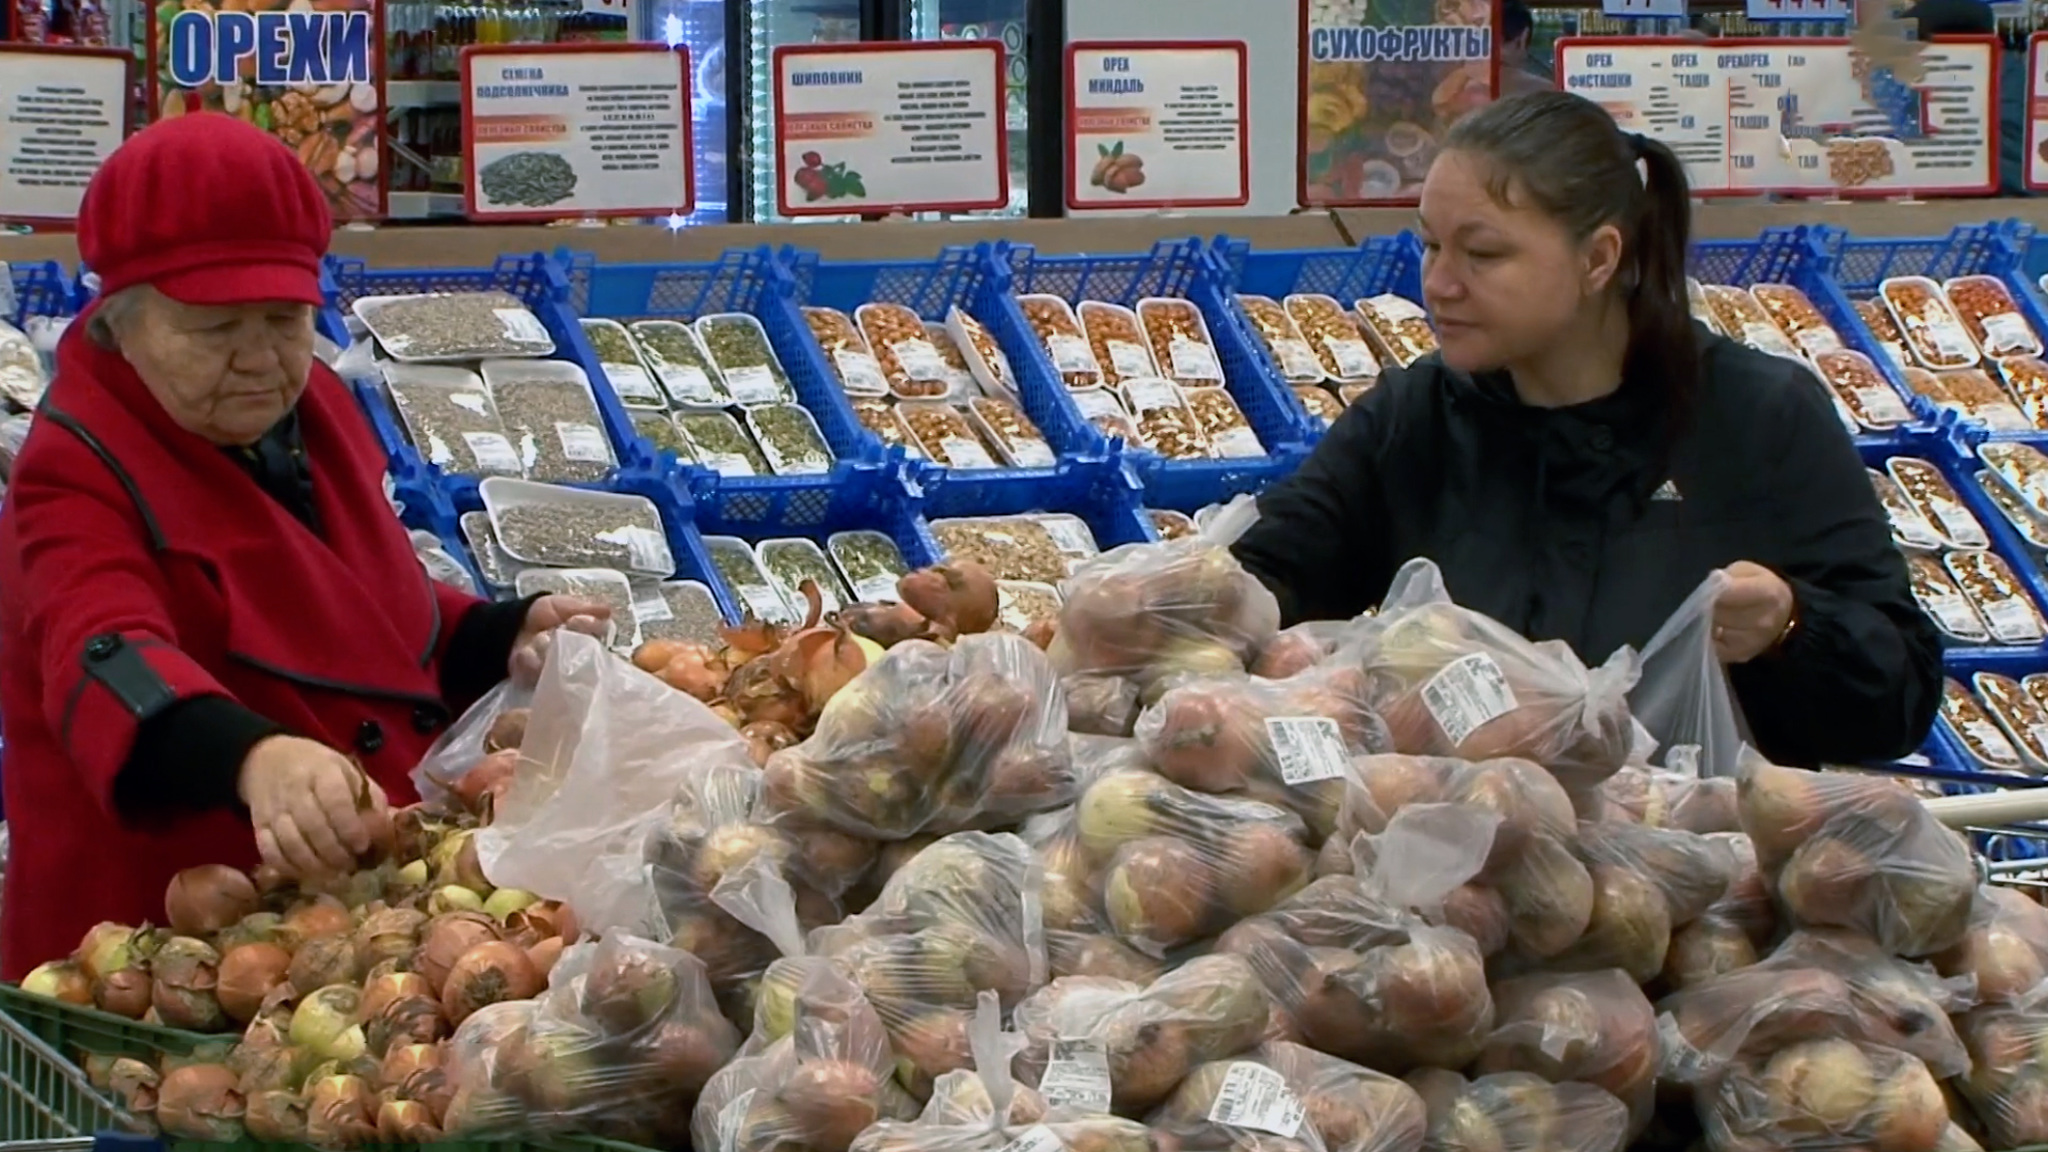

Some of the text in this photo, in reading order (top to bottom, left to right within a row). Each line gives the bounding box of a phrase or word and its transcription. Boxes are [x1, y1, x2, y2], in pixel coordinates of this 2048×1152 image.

[170, 10, 369, 86] ОРЕХИ
[1311, 27, 1490, 60] СУХОФРУКТЫ
[1103, 57, 1130, 72] ОРЕХ
[1586, 54, 1613, 67] ОРЕХ
[1672, 54, 1698, 67] ОРЕХ
[502, 67, 543, 80] СЕМЕНА
[792, 71, 863, 86] ШИПОВНИК
[1089, 79, 1145, 94] МИНДАЛЬ
[1568, 74, 1632, 88] ФИСТАШКИ
[477, 85, 569, 98] ПОДСОЛНЕЧНИКА
